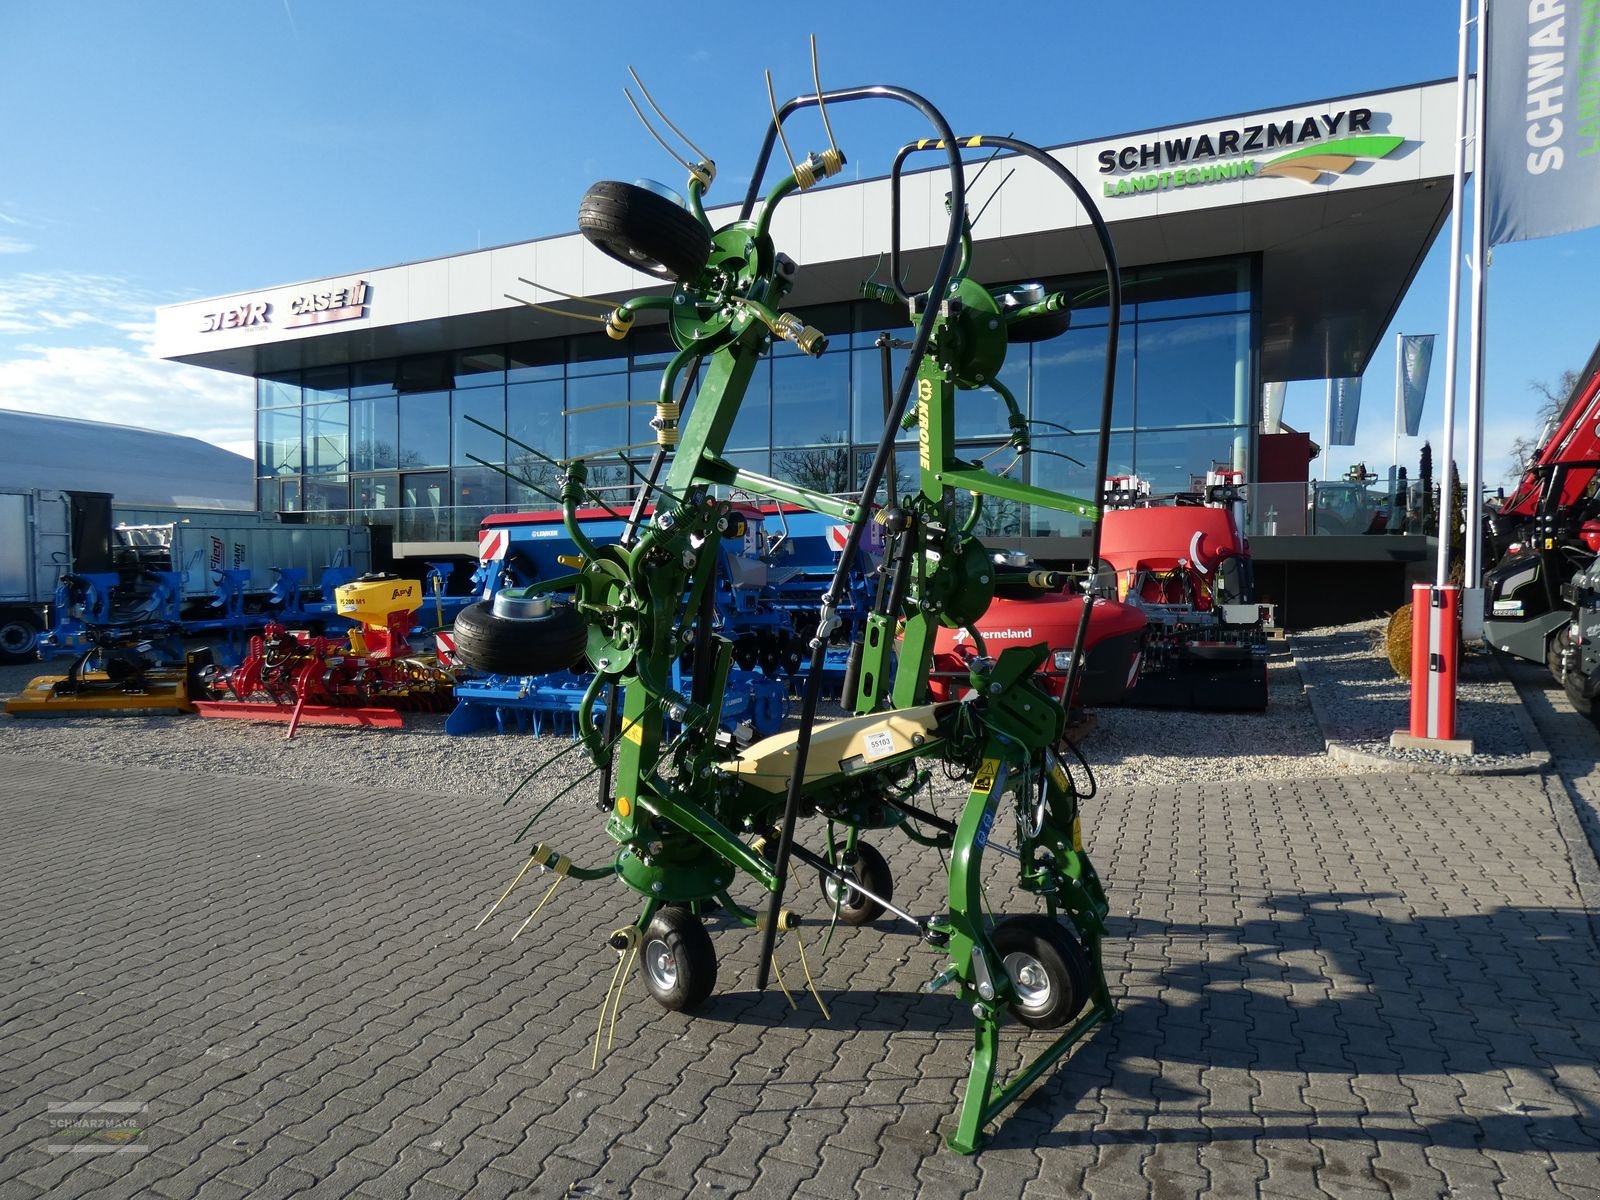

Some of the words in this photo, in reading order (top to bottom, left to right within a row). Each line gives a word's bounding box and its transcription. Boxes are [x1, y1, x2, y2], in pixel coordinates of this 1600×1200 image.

[1098, 108, 1372, 174] SCHWARZMAYR
[1103, 160, 1256, 198] LANDTECHNIK
[199, 302, 271, 333] STEYR
[290, 288, 348, 316] CASE
[919, 399, 930, 471] KRONE
[871, 738, 891, 749] 55103
